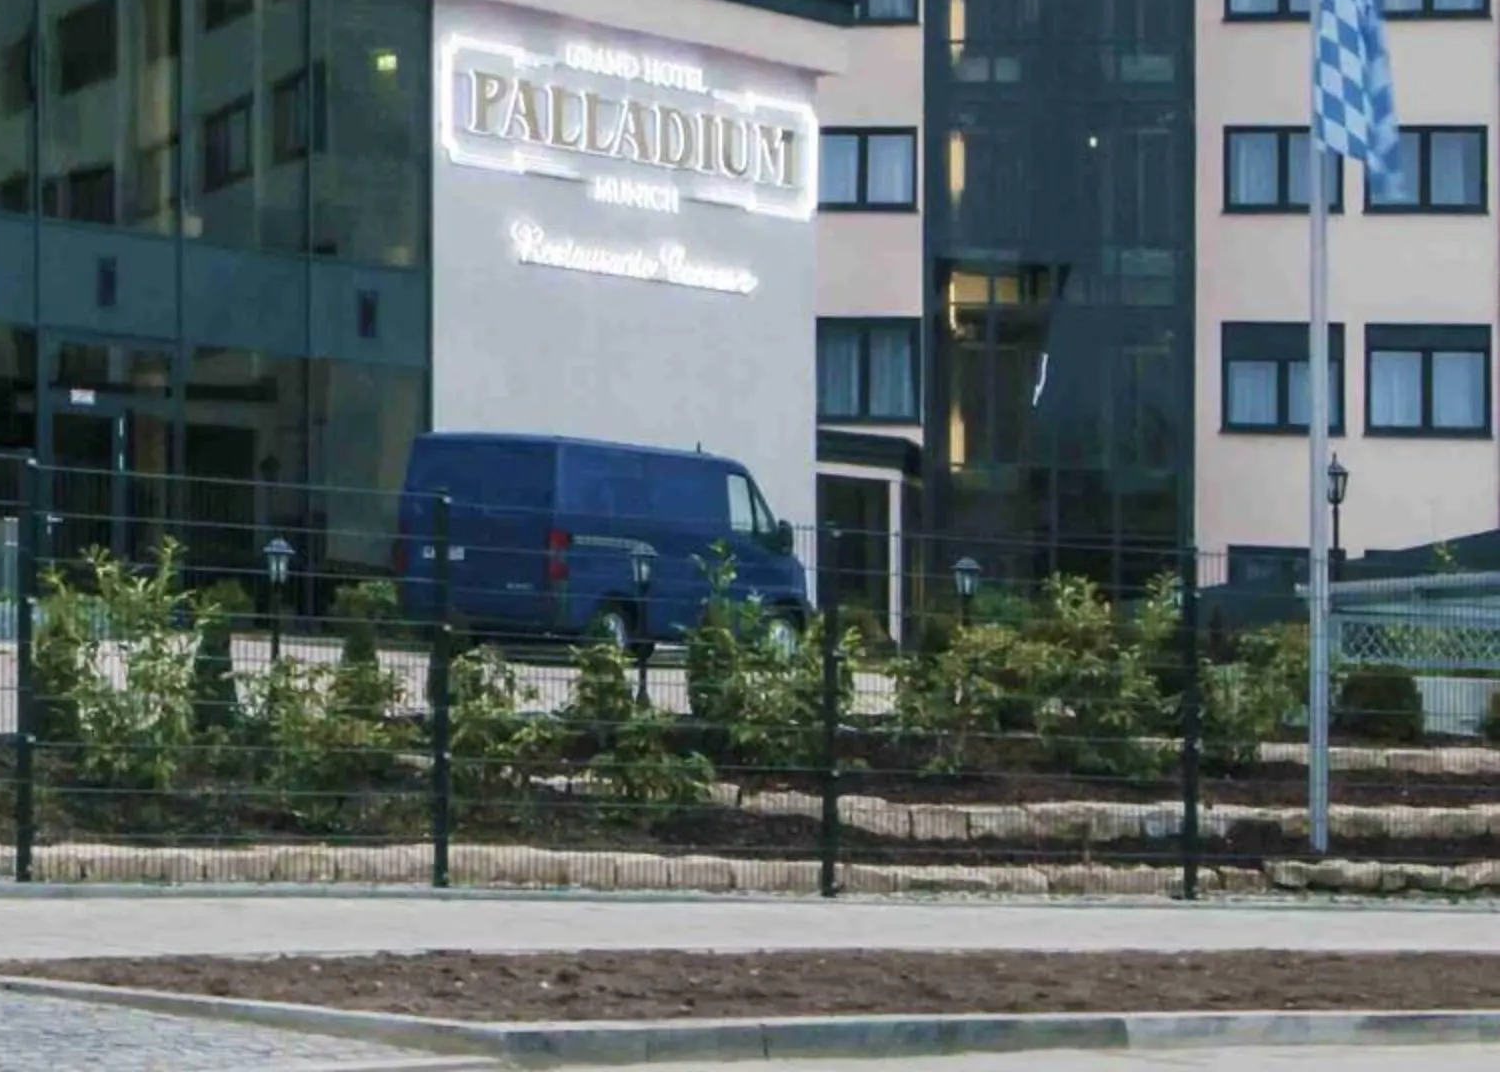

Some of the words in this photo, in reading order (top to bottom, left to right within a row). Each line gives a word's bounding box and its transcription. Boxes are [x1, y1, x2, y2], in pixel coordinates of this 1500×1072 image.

[565, 43, 640, 79] GRAND
[643, 56, 707, 93] HOTEL
[467, 69, 797, 189] PALLADIUM
[593, 176, 680, 214] MUNICH
